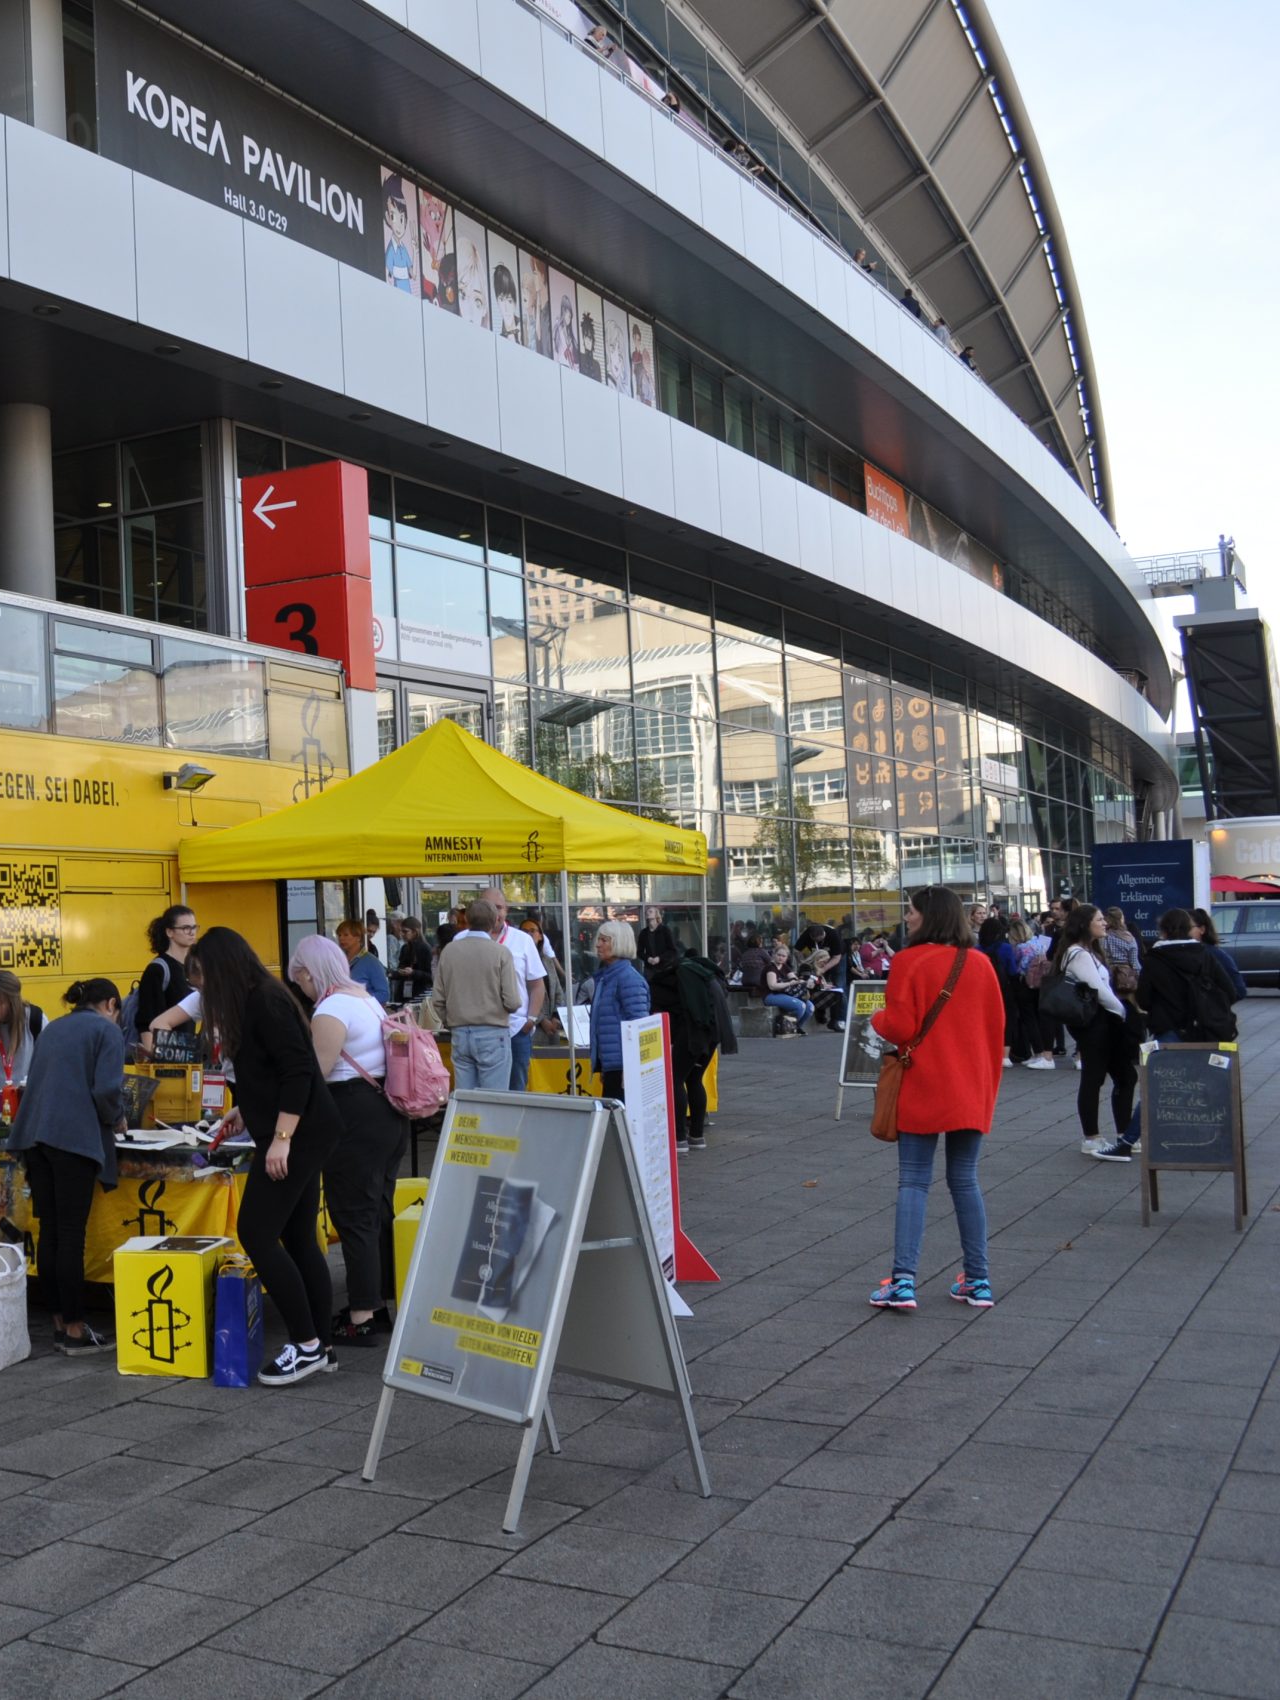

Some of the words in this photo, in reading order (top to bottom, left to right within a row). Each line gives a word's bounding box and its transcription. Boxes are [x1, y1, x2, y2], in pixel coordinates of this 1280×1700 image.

[125, 69, 231, 165] KOREA
[243, 134, 365, 235] PAVILION
[223, 186, 247, 211] Hall
[248, 198, 266, 223] 3.0
[267, 206, 288, 232] C29
[274, 602, 319, 656] 3
[45, 776, 69, 804] SEI
[73, 778, 120, 807] DABEI.
[424, 836, 483, 851] AMNESTY
[424, 852, 483, 863] INTERNATIONAL
[1117, 873, 1166, 888] Allgemeine
[1120, 891, 1164, 905] Erklärung
[1134, 909, 1150, 920] der
[458, 1117, 478, 1129] DEINE
[450, 1151, 478, 1164] WERDEN
[432, 1309, 451, 1324] ABER
[512, 1327, 539, 1346] VIELEN
